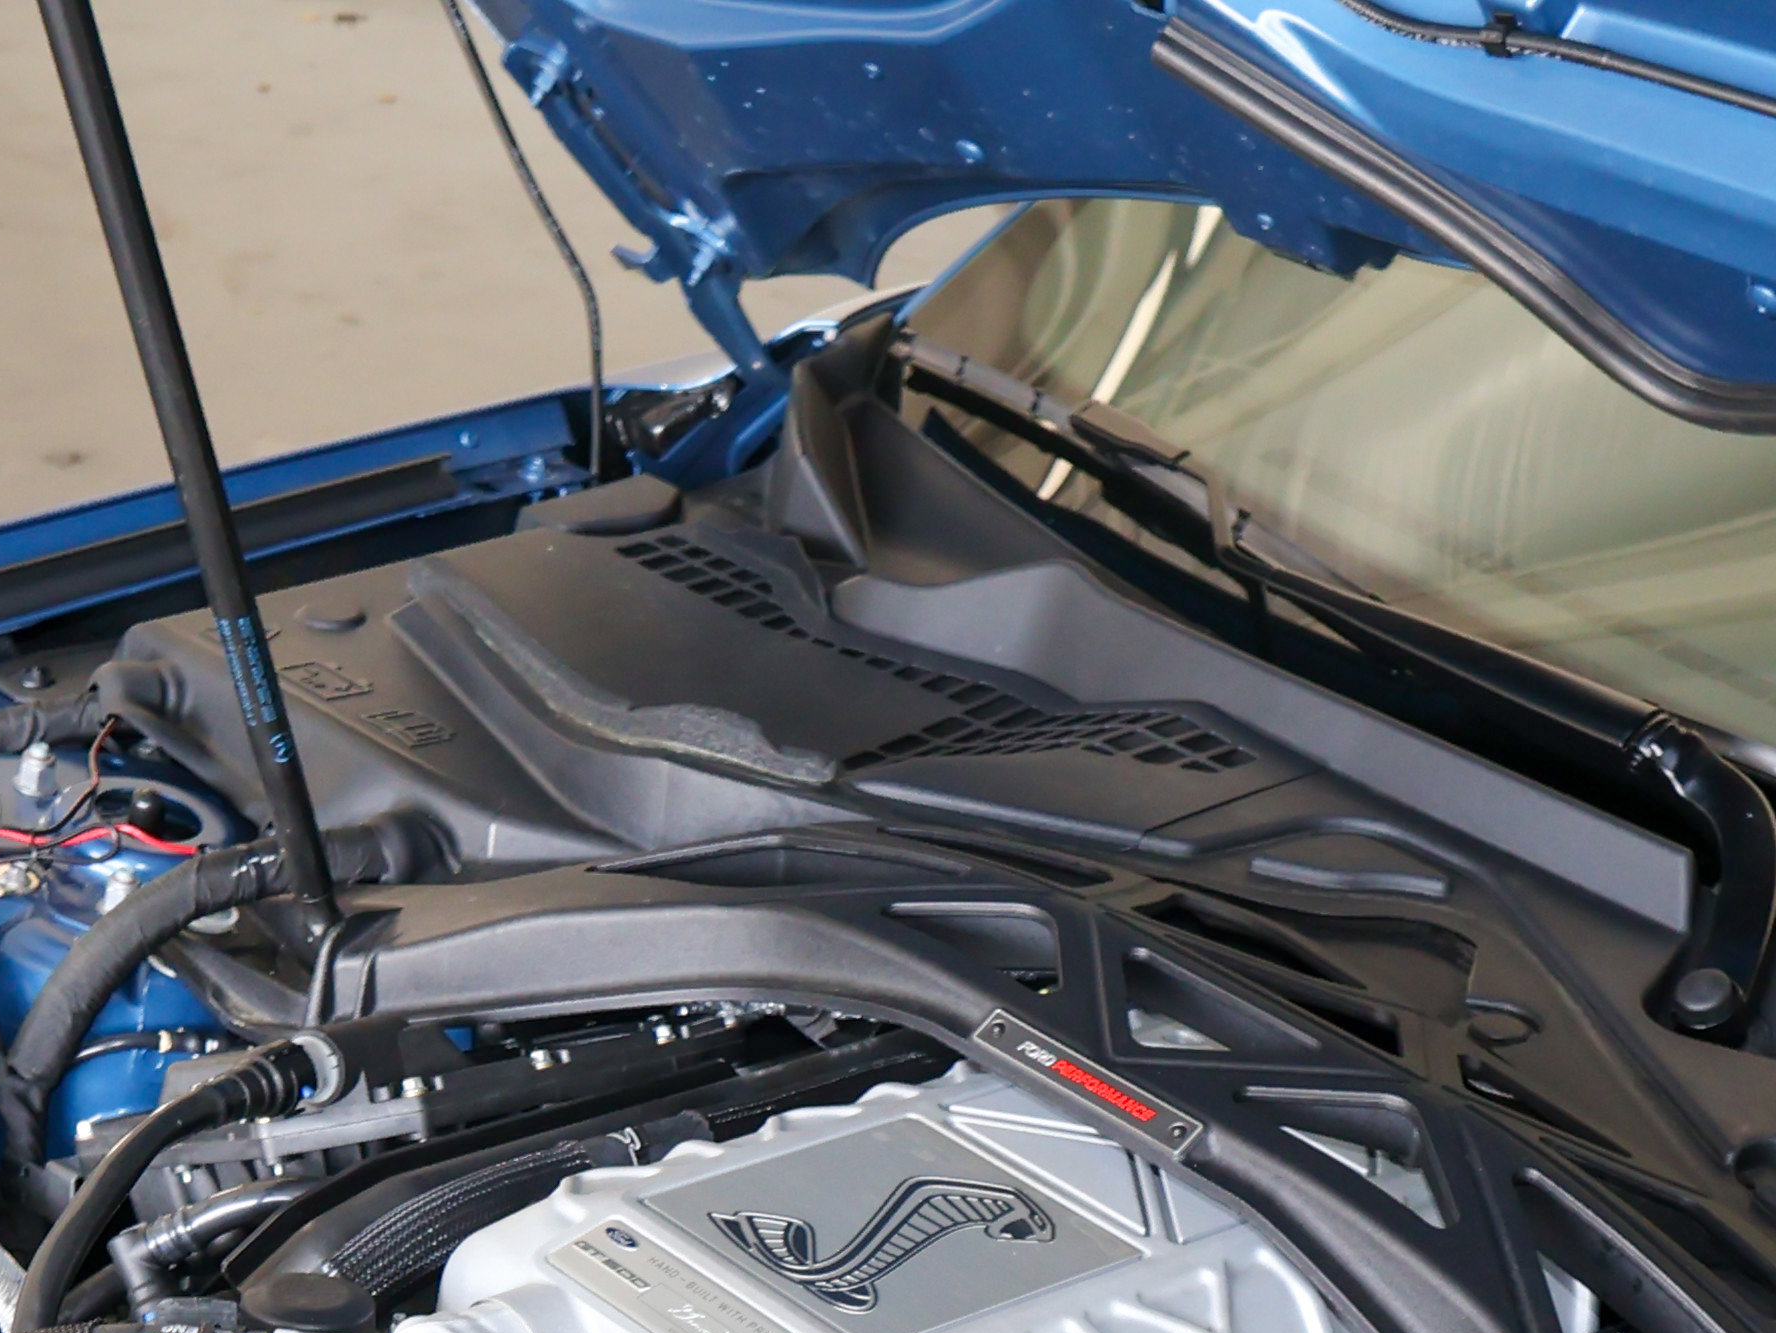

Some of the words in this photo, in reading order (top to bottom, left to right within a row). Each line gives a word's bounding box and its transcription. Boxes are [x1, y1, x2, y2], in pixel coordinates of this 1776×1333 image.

[1017, 1041, 1057, 1067] FORD
[1052, 1059, 1157, 1121] PERFORMANCE
[718, 1301, 747, 1325] WITH
